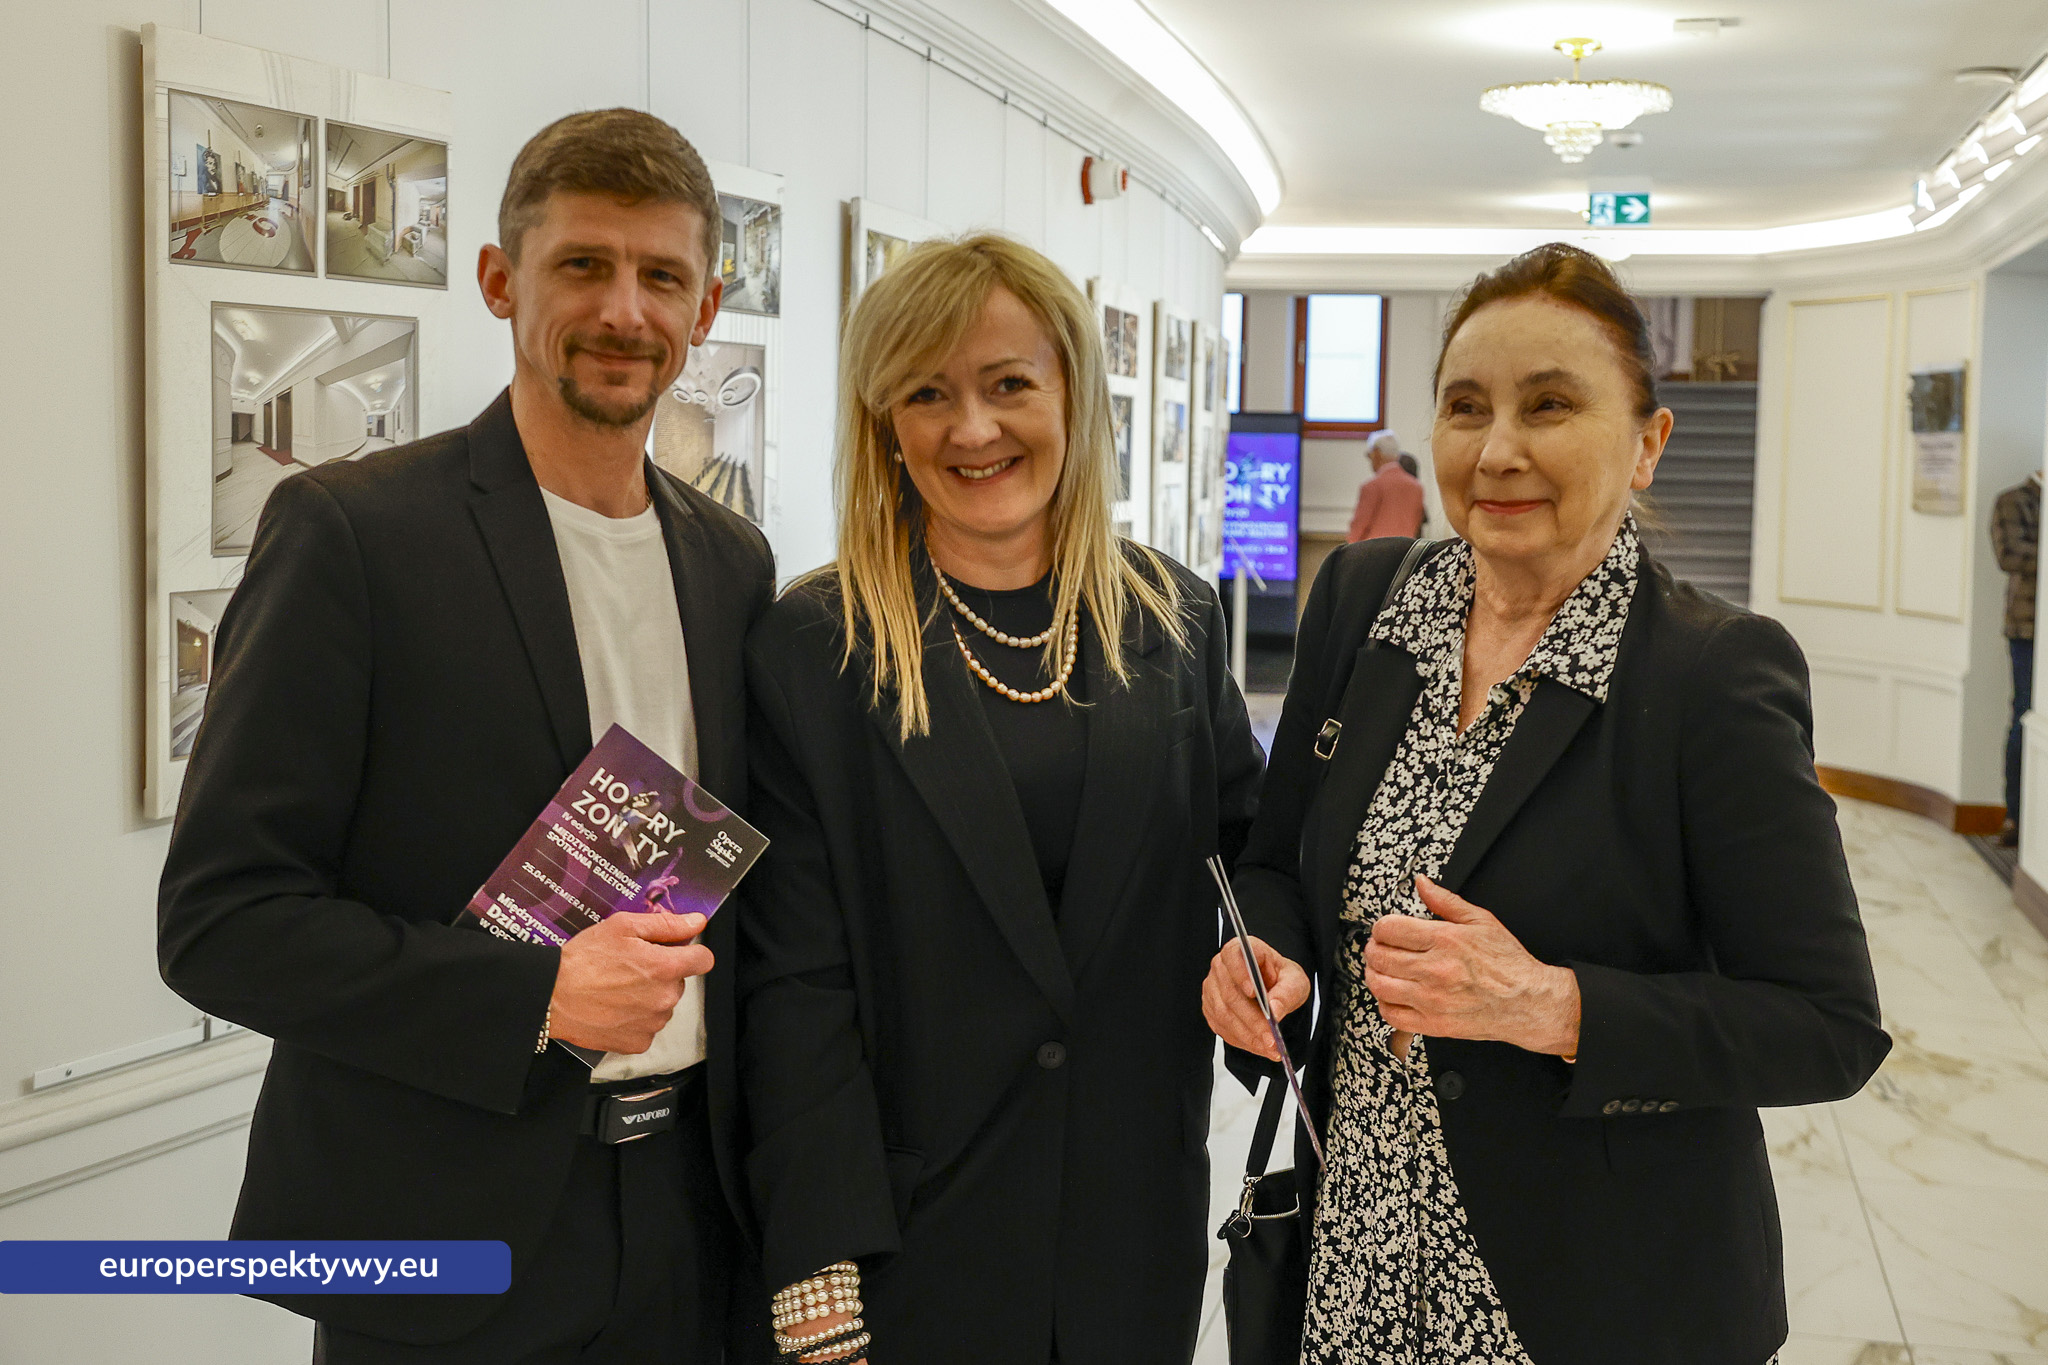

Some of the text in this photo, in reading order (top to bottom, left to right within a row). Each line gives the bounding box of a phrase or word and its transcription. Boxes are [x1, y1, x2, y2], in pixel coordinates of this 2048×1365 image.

[1260, 462, 1292, 483] RY
[570, 819, 598, 842] edycja
[571, 789, 629, 840] ZON
[636, 832, 669, 866] TY
[589, 766, 686, 844] HO RY
[546, 830, 637, 901] SPOTKANIA BALETOWE
[552, 823, 642, 894] MIĘDZYPOKOLENIOWE
[717, 830, 743, 854] Opera
[521, 861, 547, 883] 25.04
[543, 877, 585, 912] PREMIERA
[486, 903, 531, 942] Dzień
